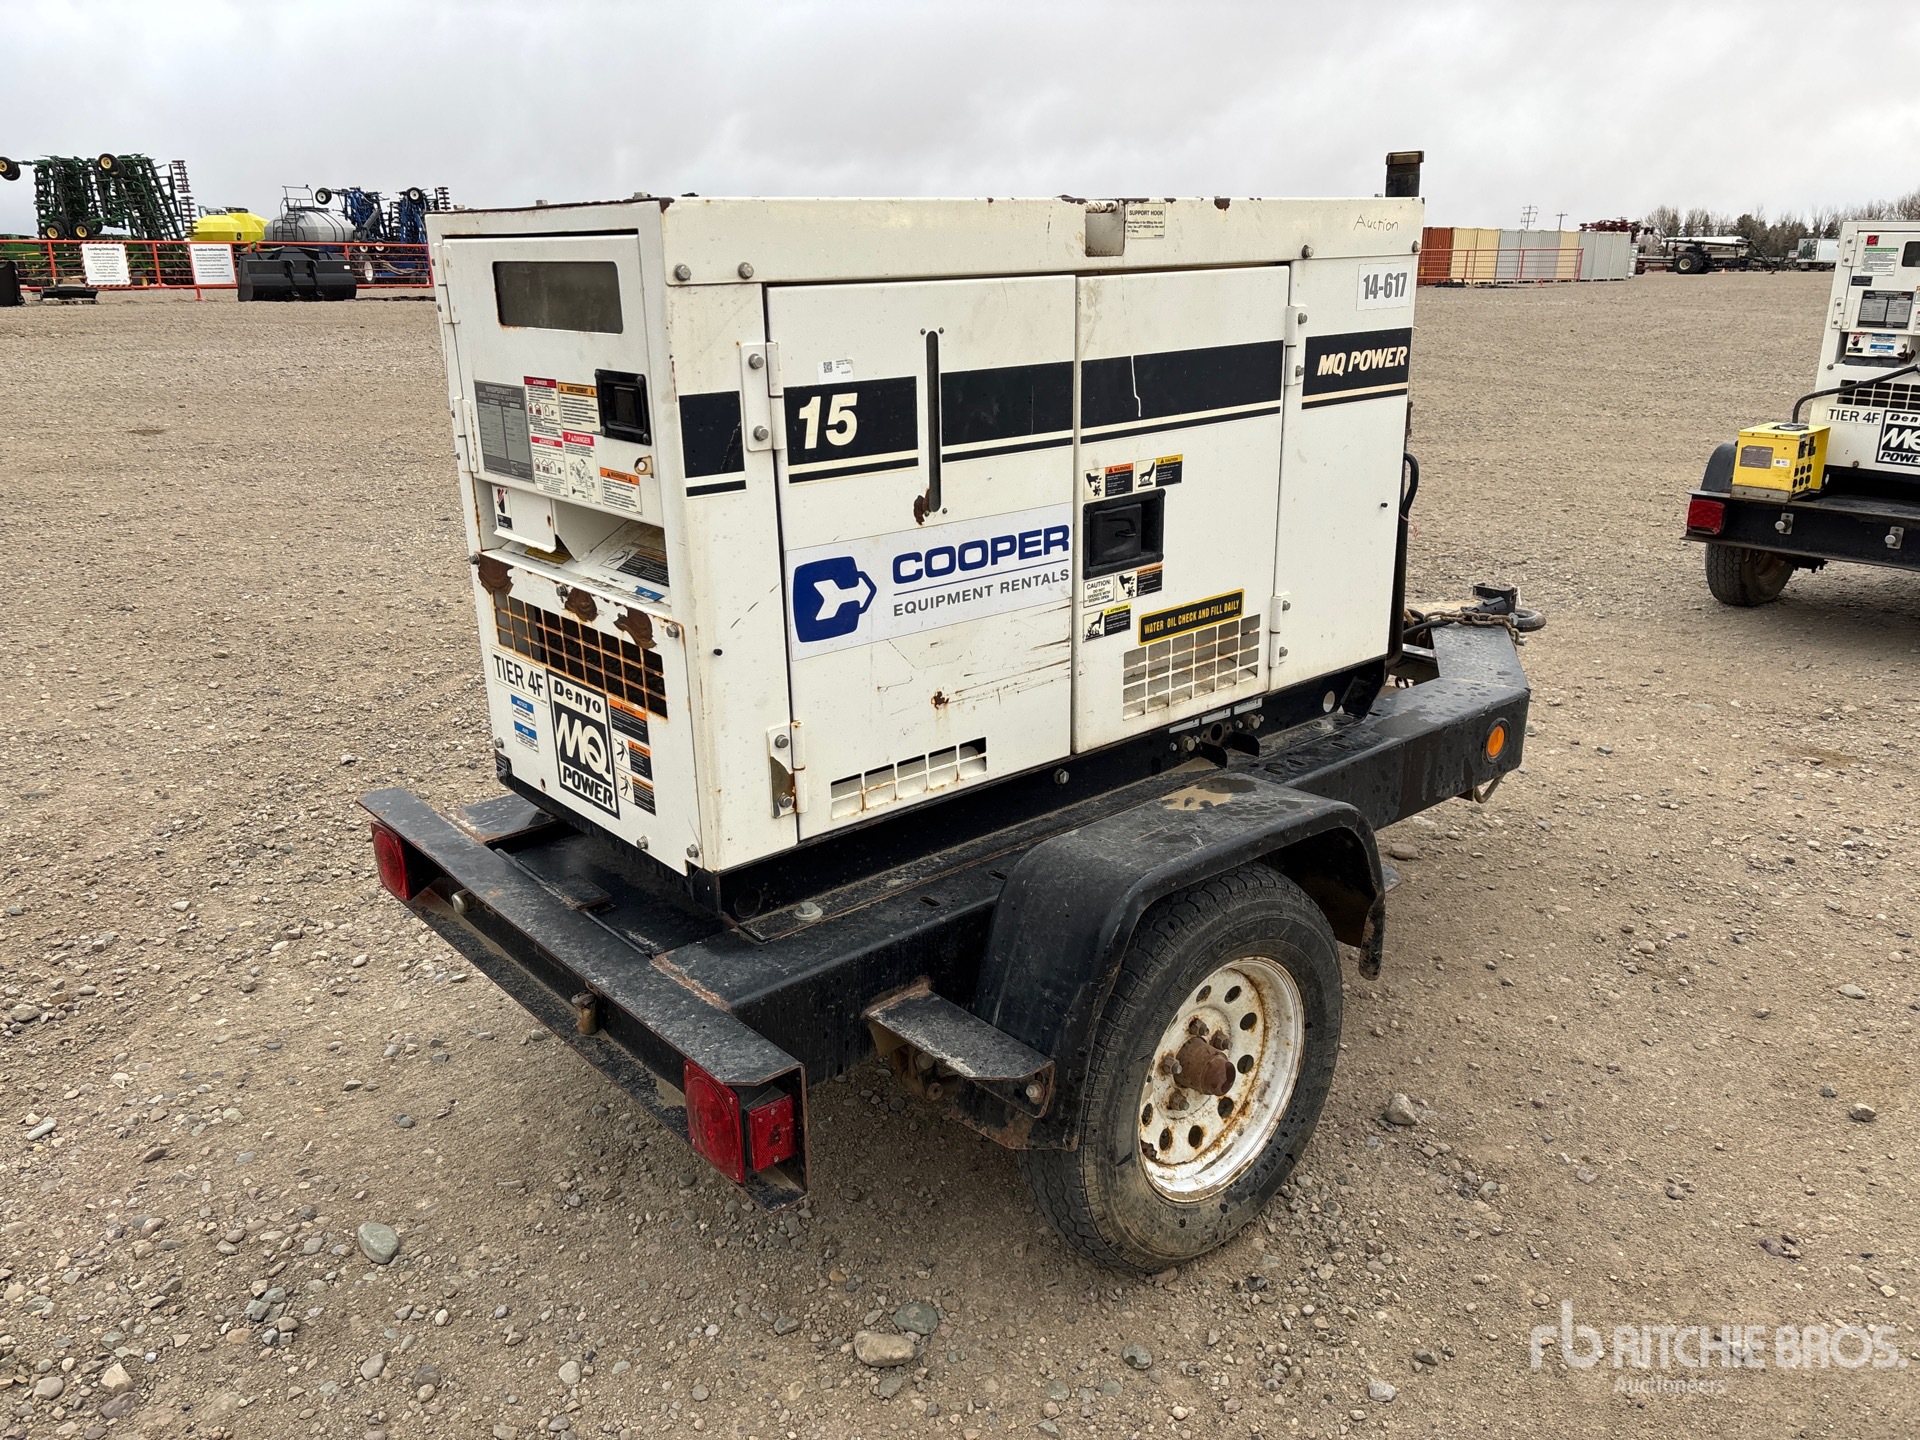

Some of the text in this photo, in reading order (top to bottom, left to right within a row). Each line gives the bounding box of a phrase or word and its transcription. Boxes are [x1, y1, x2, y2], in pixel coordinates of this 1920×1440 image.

[1353, 214, 1399, 231] Auction
[1364, 272, 1407, 300] 14-617
[1316, 346, 1408, 376] MQ POWER
[798, 392, 858, 449] 15
[1829, 409, 1880, 423] TIER 4F
[1890, 414, 1920, 425] Den
[573, 436, 591, 444] DANGER
[1880, 452, 1920, 464] POWE
[892, 524, 1069, 584] COOPER
[893, 569, 1070, 617] EQUIPMENT RENTALS
[1087, 578, 1111, 589] CAUTION:
[1144, 620, 1164, 635] WATER
[1167, 617, 1177, 628] OIL
[1178, 611, 1197, 625] CHECK
[1197, 608, 1209, 620] AND
[1211, 605, 1223, 616] FILL
[1224, 600, 1240, 613] DAILY
[493, 654, 544, 697] TIER 4F
[554, 680, 602, 714] Denyo
[557, 712, 612, 785] MQ
[563, 766, 613, 808] POWER
